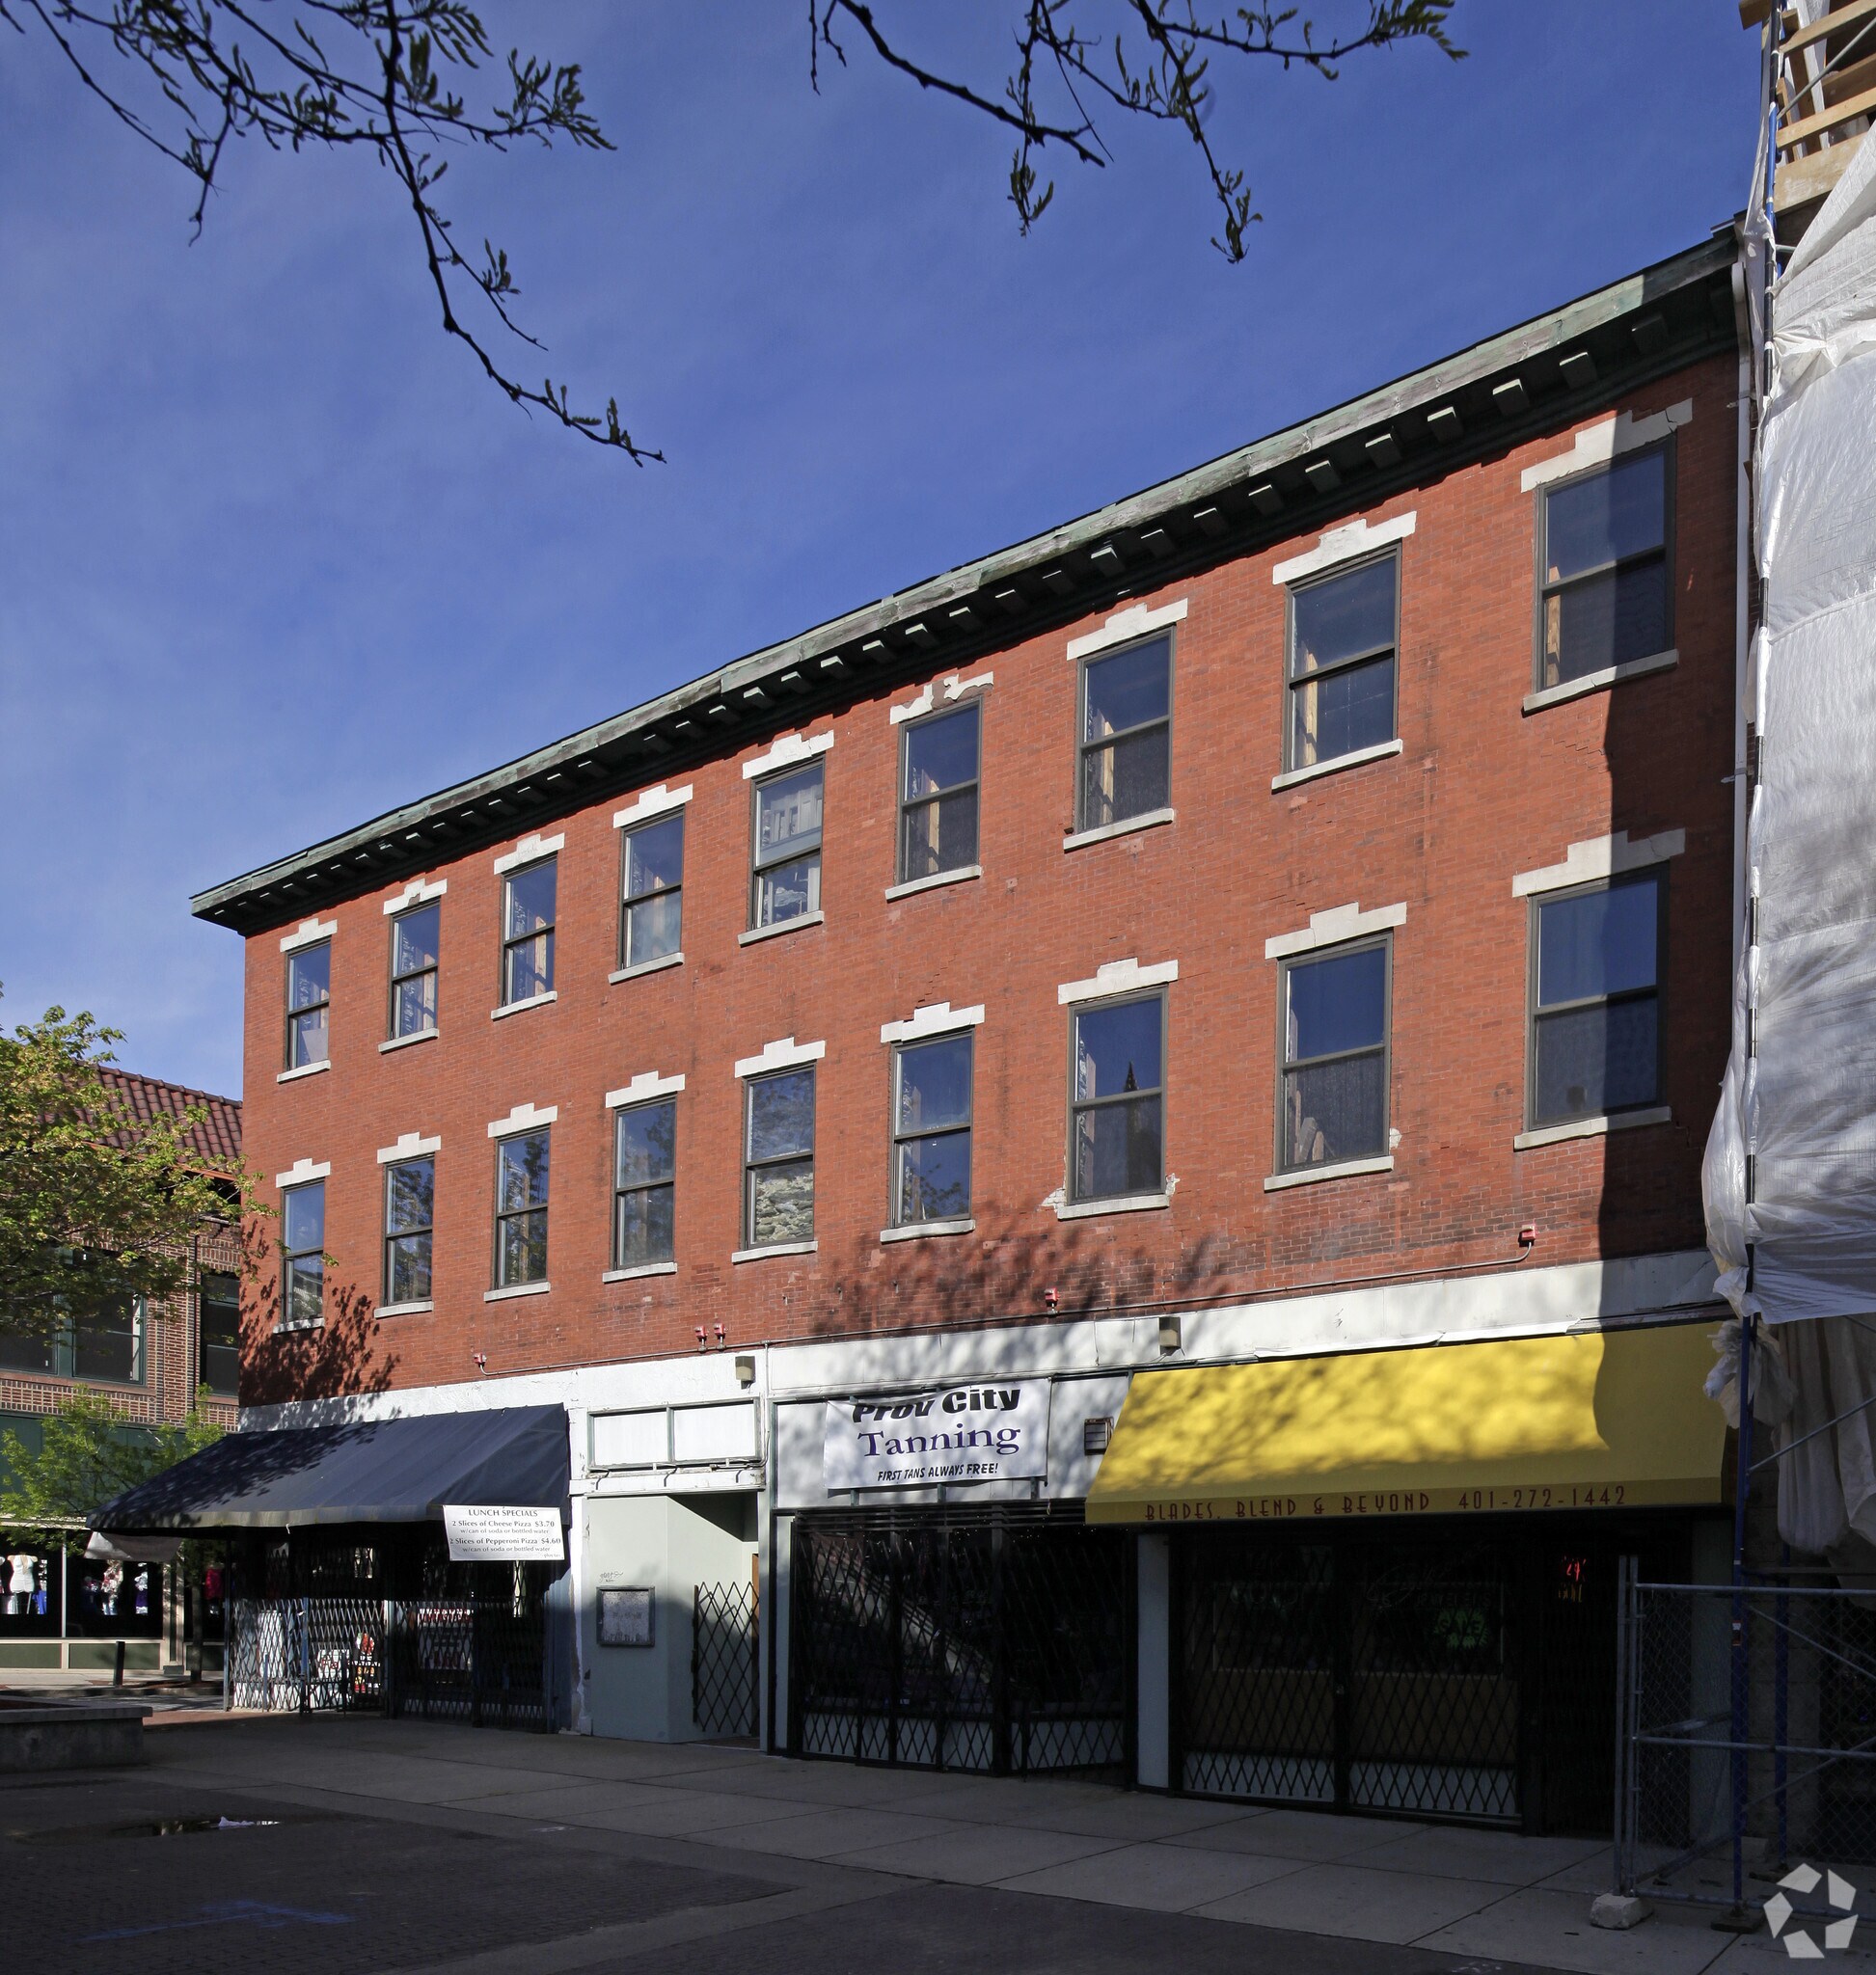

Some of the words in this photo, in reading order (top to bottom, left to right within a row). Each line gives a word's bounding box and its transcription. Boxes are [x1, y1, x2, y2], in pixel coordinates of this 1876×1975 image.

[853, 1400, 935, 1423] Prov
[942, 1390, 1020, 1414] City
[857, 1423, 1020, 1456] Tanning
[878, 1471, 902, 1481] FIRST
[904, 1468, 926, 1479] TANS
[928, 1465, 964, 1477] ALWAYS
[966, 1463, 998, 1474] FREE!
[1236, 1499, 1296, 1518] BLEND
[1314, 1497, 1325, 1514] &
[1343, 1493, 1429, 1513] BEYOND
[1458, 1486, 1624, 1509] 401-272-1442
